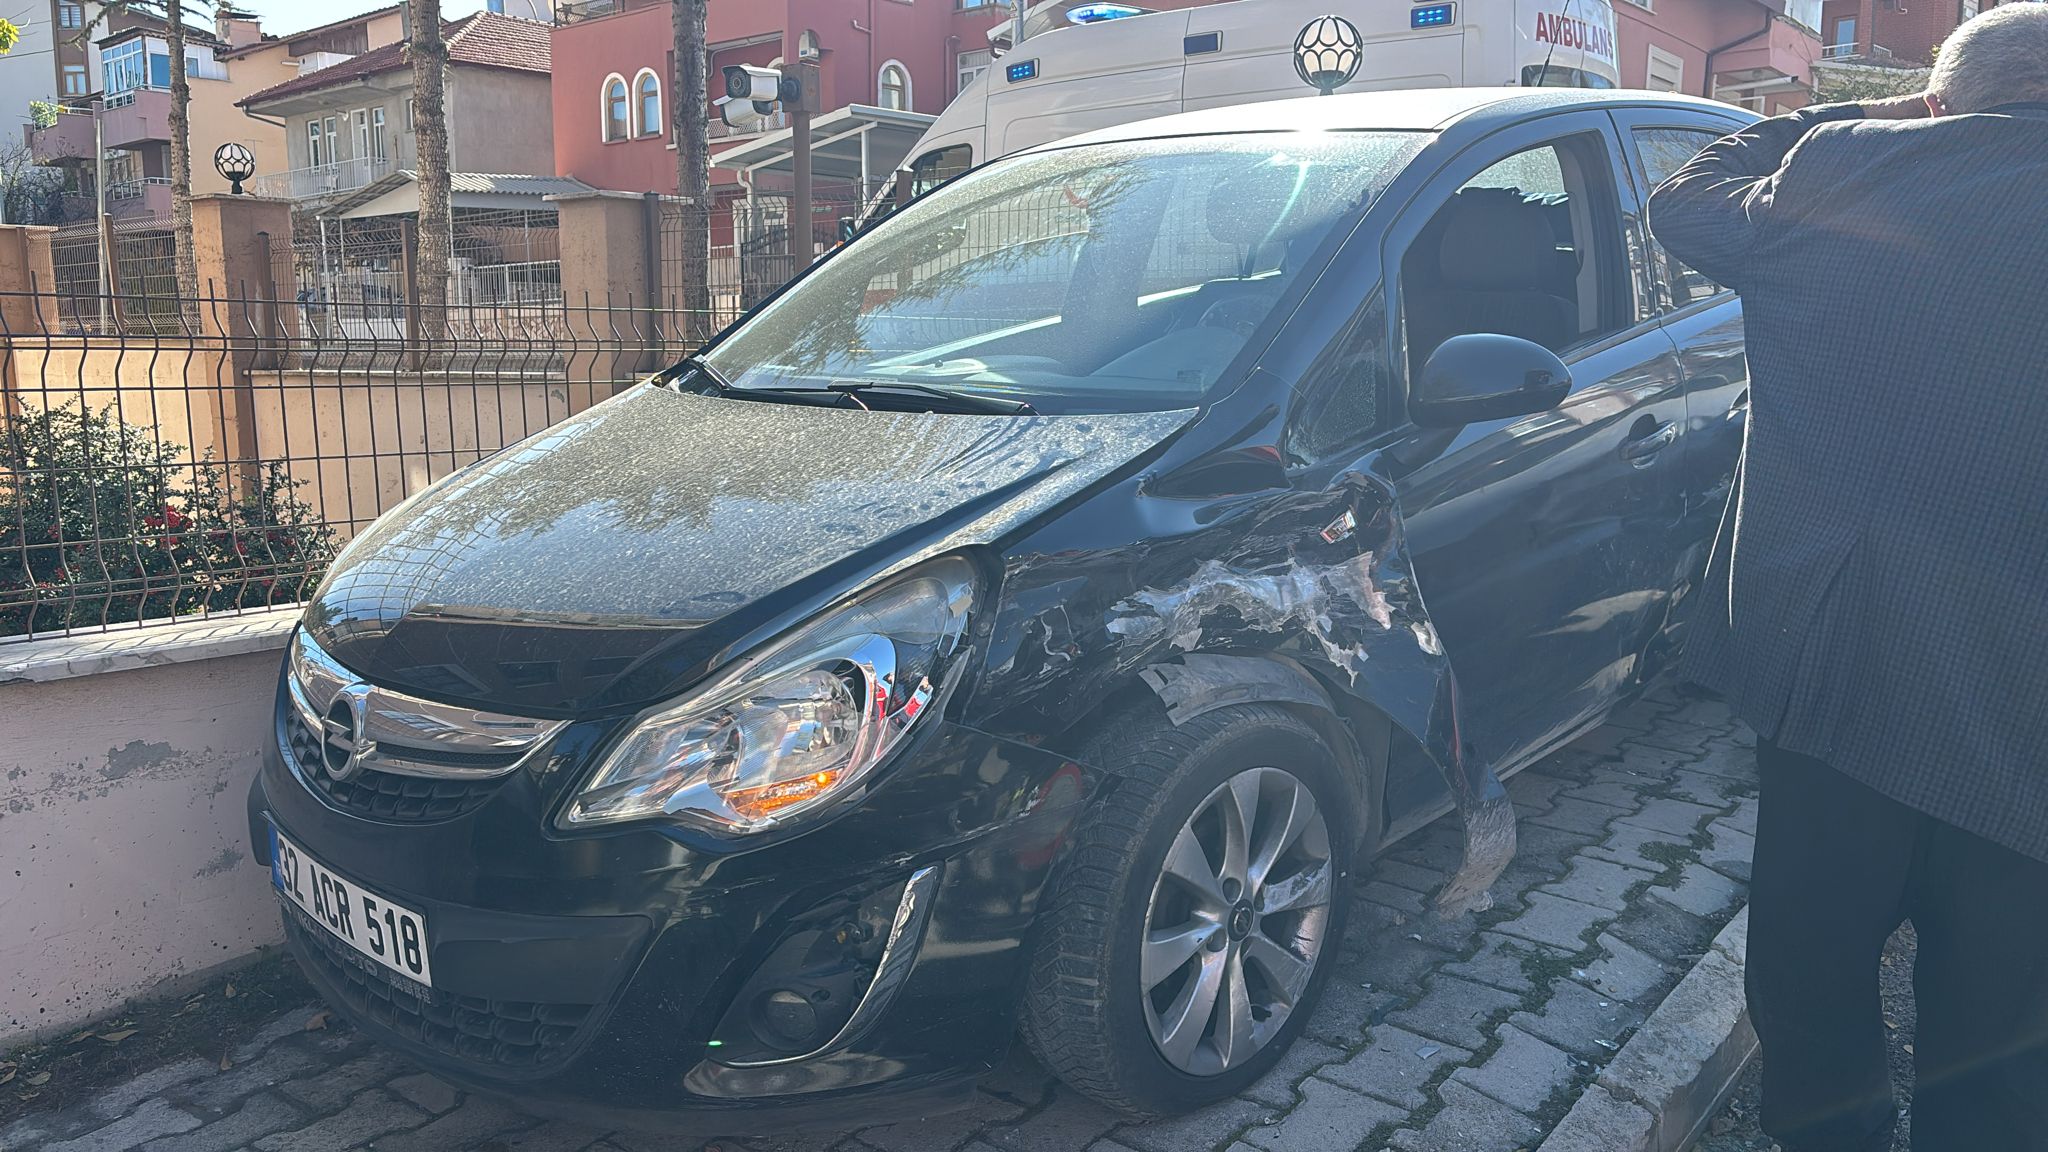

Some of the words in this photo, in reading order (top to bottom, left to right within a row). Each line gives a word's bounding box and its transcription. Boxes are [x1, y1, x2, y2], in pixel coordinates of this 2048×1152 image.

[1536, 12, 1614, 60] AMBULANS
[278, 838, 305, 903] 32
[310, 864, 355, 941] ACR
[362, 896, 423, 976] 518
